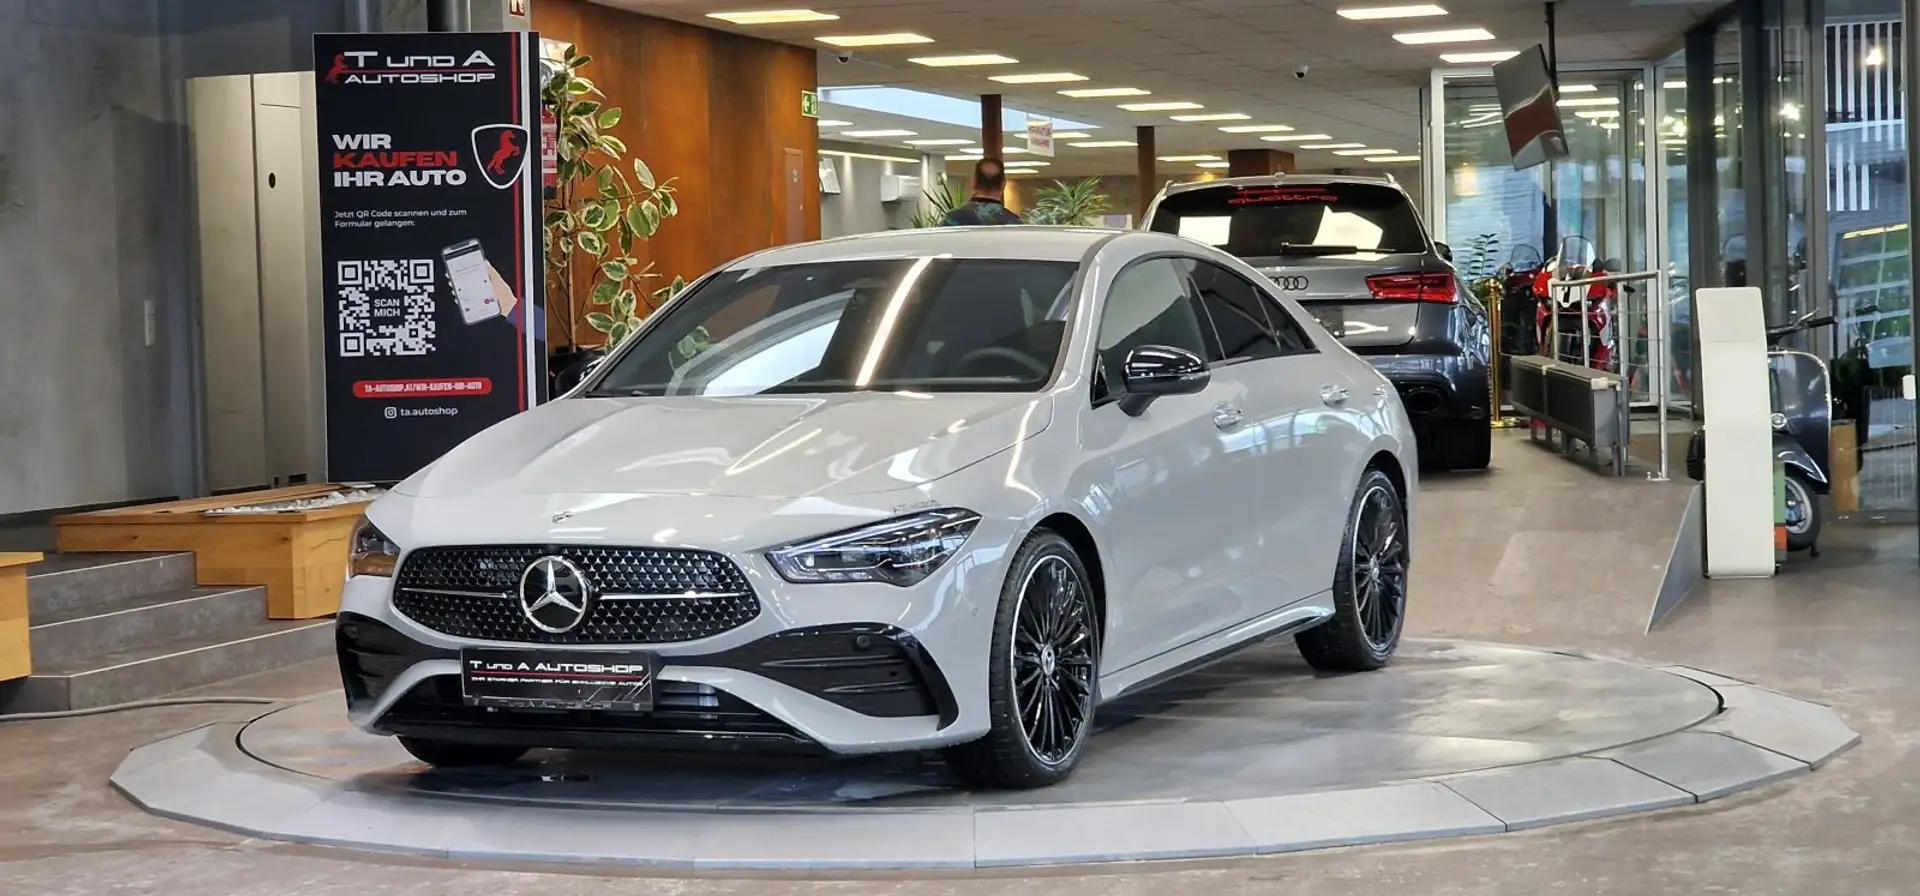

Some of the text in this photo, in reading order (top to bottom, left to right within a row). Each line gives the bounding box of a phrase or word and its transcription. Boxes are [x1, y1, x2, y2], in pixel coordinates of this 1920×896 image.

[343, 51, 378, 67] T
[462, 50, 495, 67] A
[344, 73, 495, 84] AUTOSHOP
[332, 134, 391, 149] WIR
[333, 151, 458, 168] KAUFEN
[334, 169, 467, 187] IHR AUTO
[334, 208, 467, 219] Jetzt QR Code scannen und zum
[335, 219, 415, 228] Formular gelangen:
[374, 298, 400, 308] SCAN
[374, 308, 400, 317] MICH
[400, 406, 458, 417] ta.autoshop
[469, 660, 482, 669] T
[517, 662, 531, 671] A
[535, 663, 643, 673] AUTOSHOP
